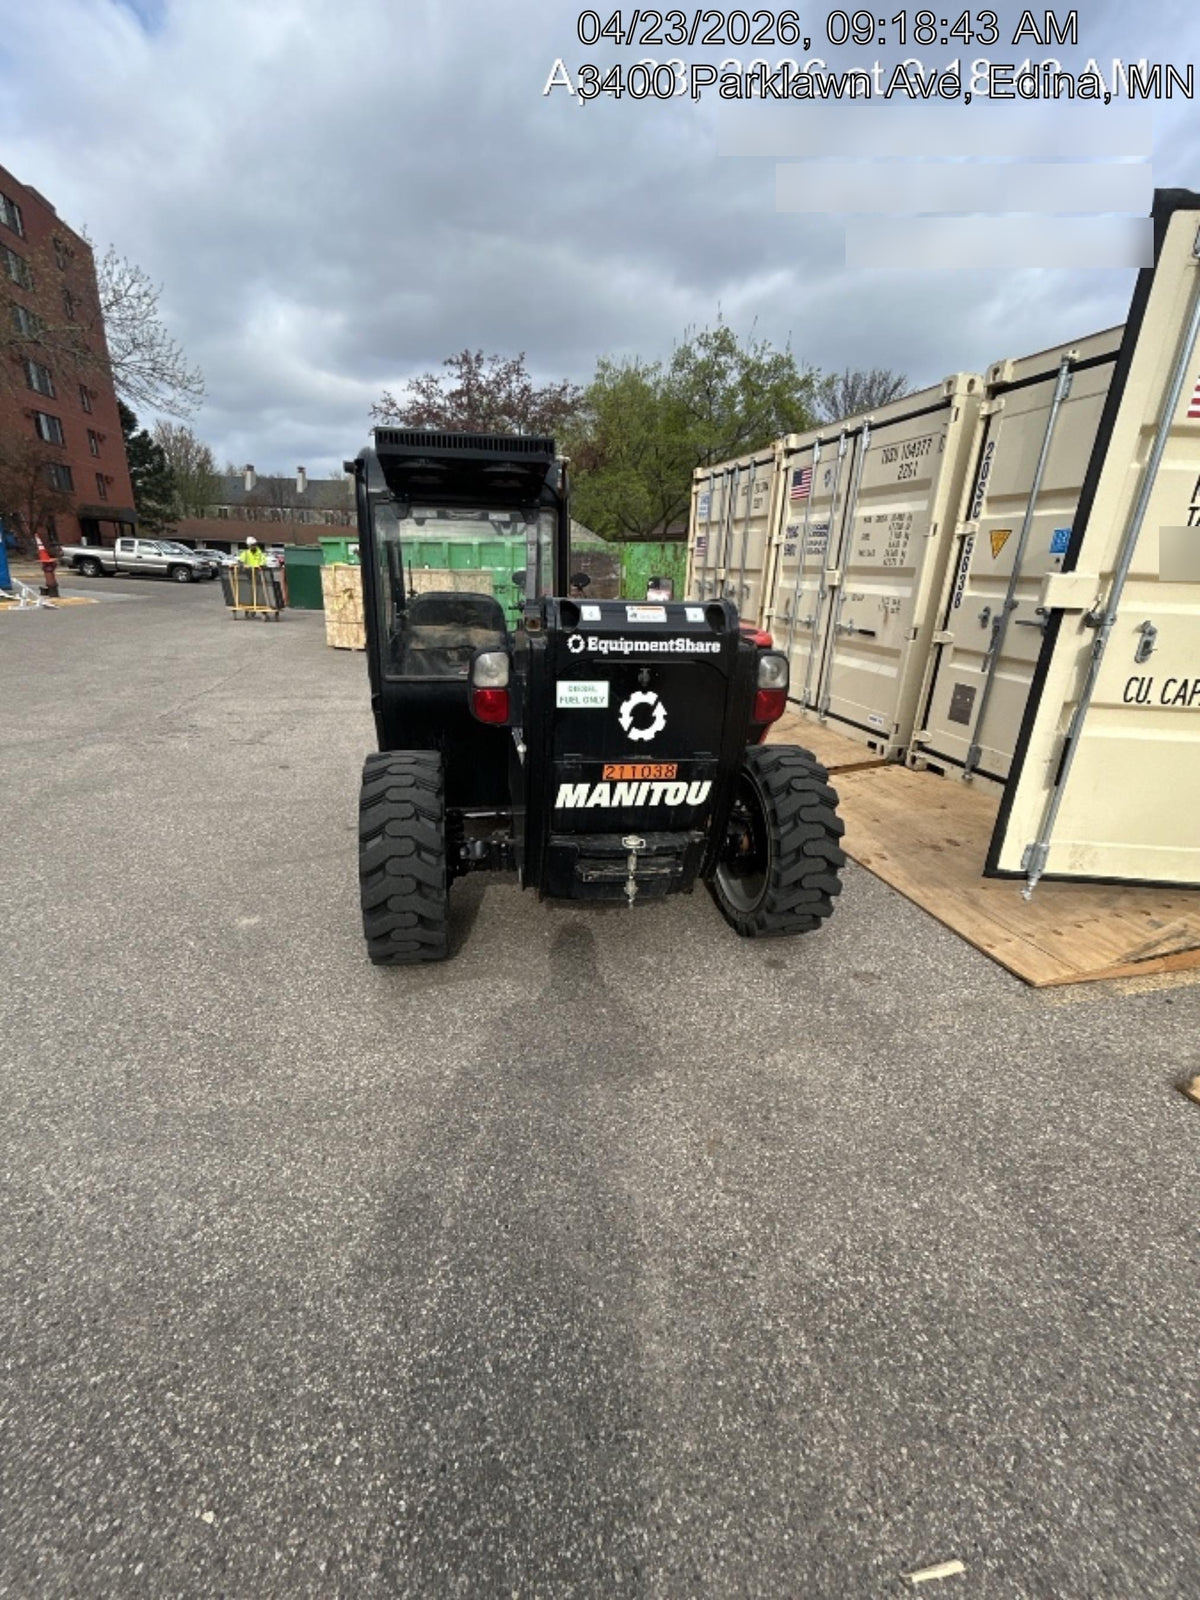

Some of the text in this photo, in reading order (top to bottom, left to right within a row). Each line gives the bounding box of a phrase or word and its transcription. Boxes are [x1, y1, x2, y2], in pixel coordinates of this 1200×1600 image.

[587, 636, 721, 654] EquipmentShare
[1124, 676, 1153, 705] CU.
[560, 696, 605, 704] FUEL ONLY
[605, 764, 674, 779] 211038
[555, 781, 712, 808] MANITOU
